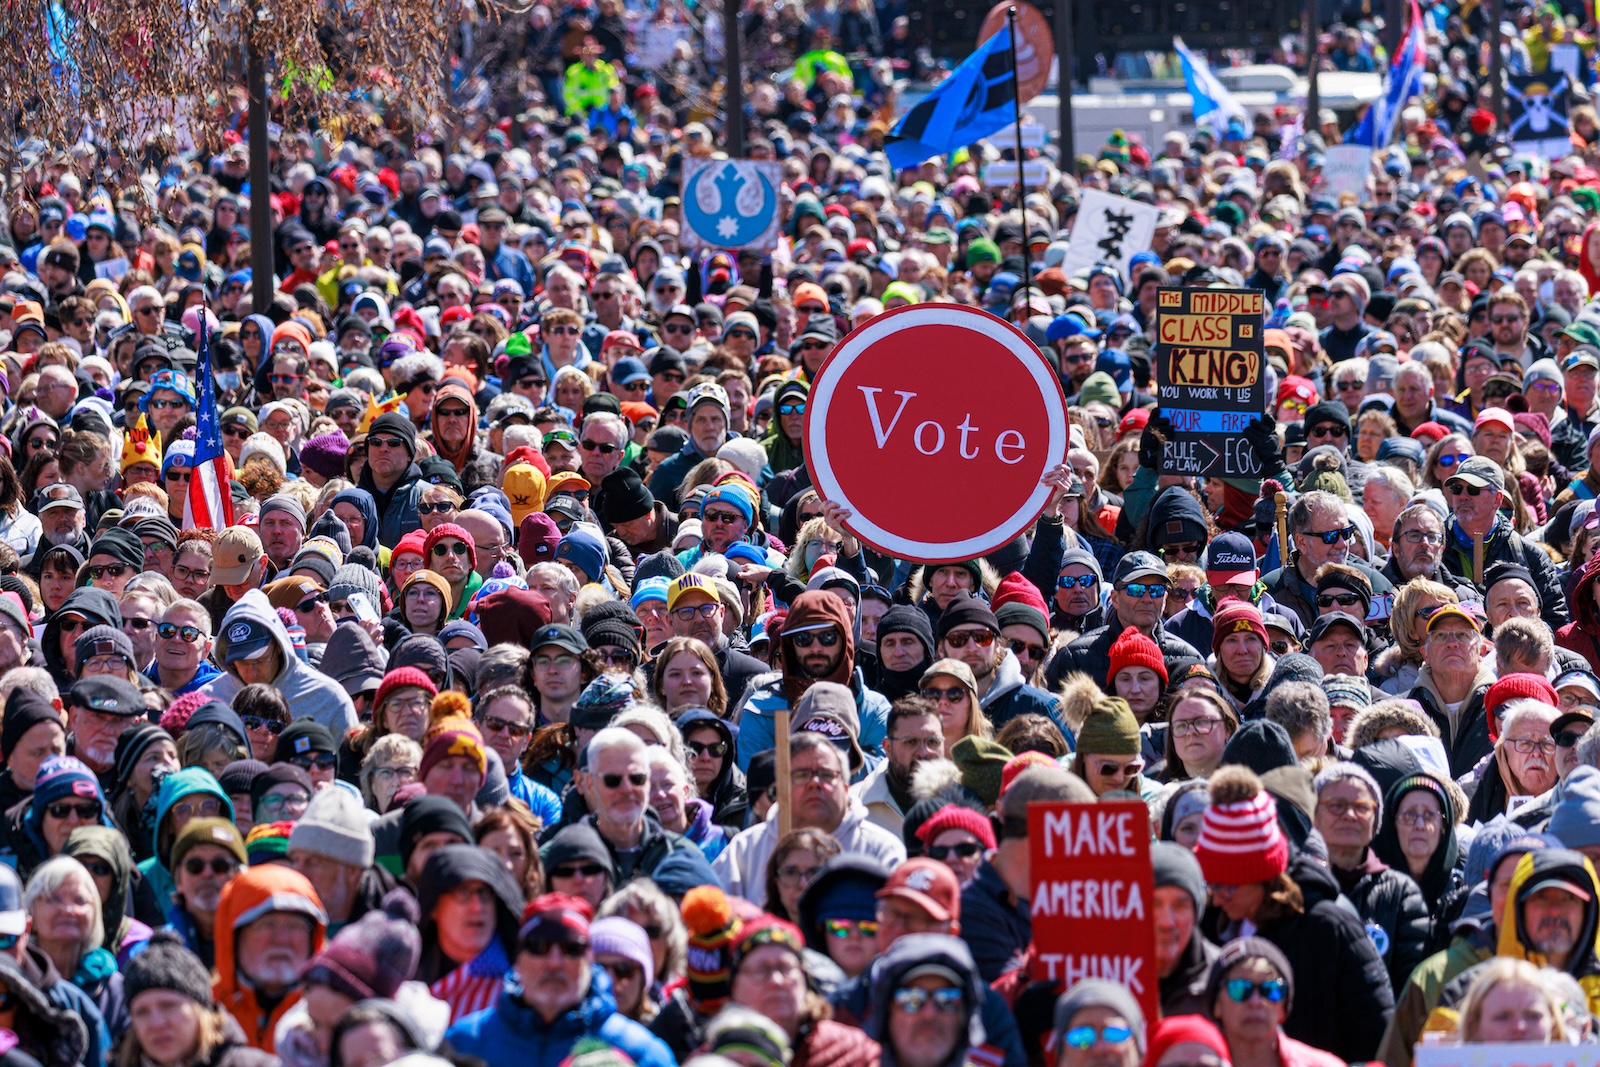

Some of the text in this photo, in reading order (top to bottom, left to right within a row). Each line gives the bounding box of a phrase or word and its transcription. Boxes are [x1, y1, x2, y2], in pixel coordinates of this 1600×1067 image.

[1193, 294, 1261, 314] MIDDLE
[1162, 315, 1250, 342] CLASS IS
[1171, 347, 1256, 386] KING!
[1160, 387, 1251, 401] YOU WORK 4 US
[857, 386, 1026, 464] Vote
[1169, 410, 1201, 432] YOUR
[130, 428, 149, 444] NO
[1163, 440, 1198, 461] RULE
[1163, 460, 1202, 474] OF LAW
[1214, 552, 1252, 565] Titleist
[678, 574, 703, 591] MIN
[1233, 620, 1253, 632] M
[803, 716, 843, 736] Twins
[1044, 812, 1135, 856] MAKE
[1033, 881, 1143, 919] AMERICA
[1041, 954, 1143, 993] THINK
